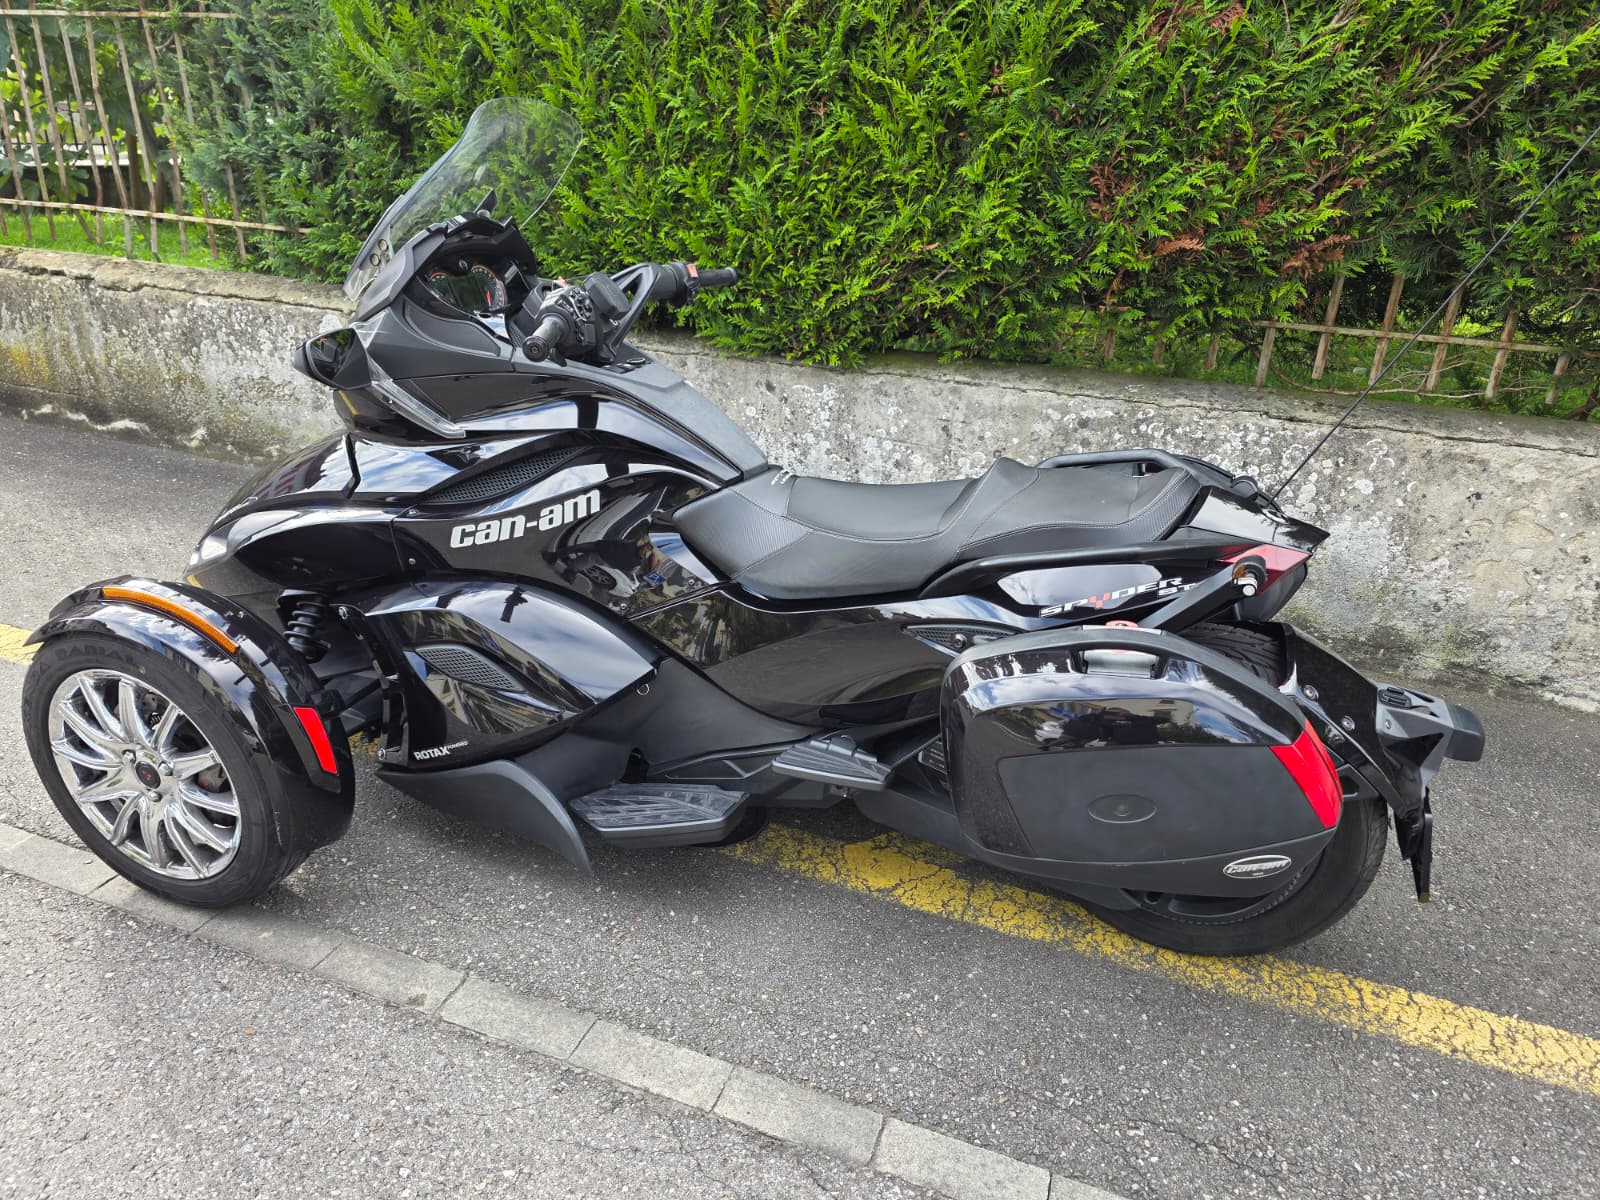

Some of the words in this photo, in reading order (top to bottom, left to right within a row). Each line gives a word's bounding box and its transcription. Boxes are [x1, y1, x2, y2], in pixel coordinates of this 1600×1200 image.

[450, 489, 600, 548] can-am
[1039, 577, 1182, 617] SPYDER
[413, 746, 450, 760] ROTAX
